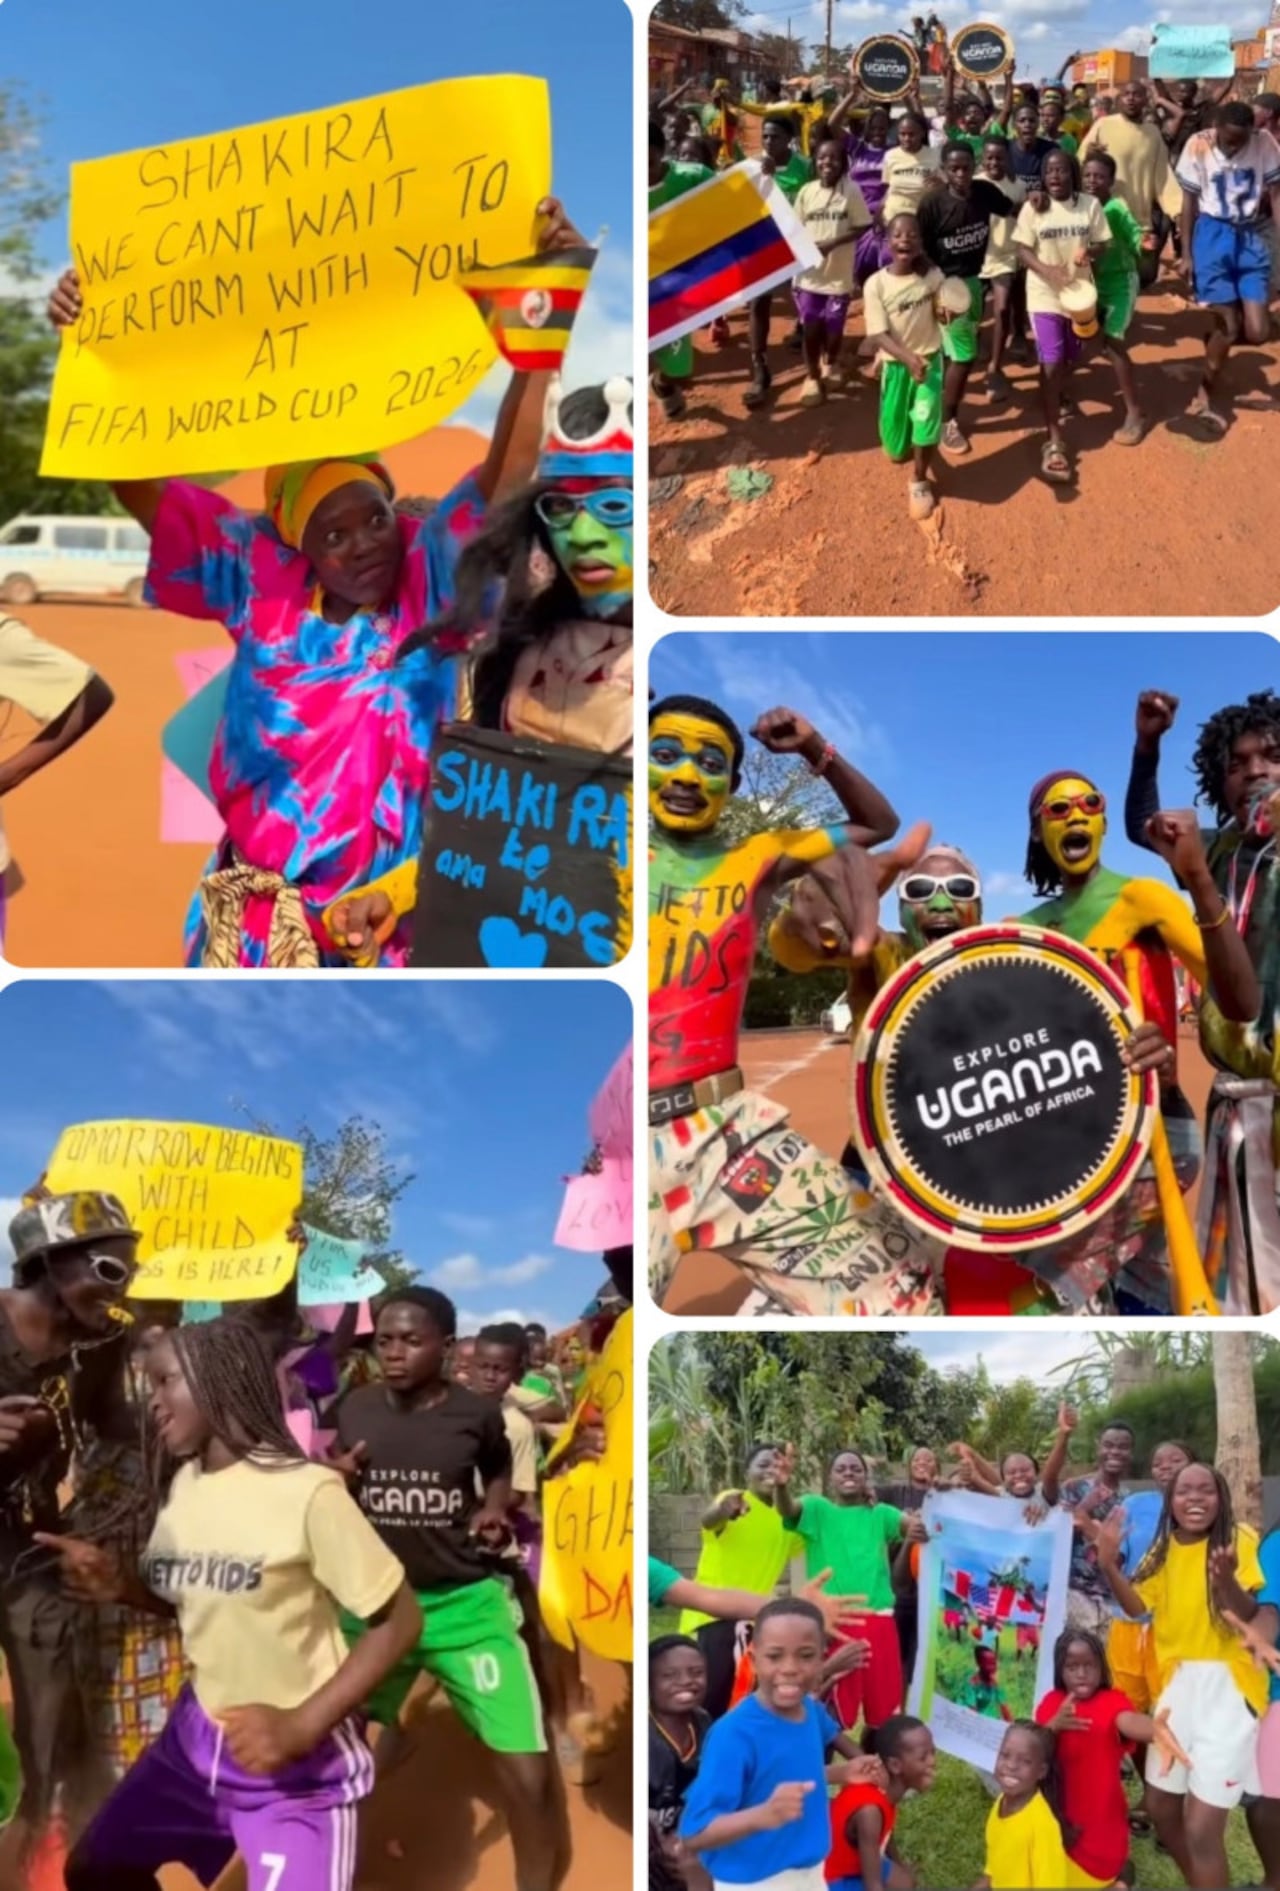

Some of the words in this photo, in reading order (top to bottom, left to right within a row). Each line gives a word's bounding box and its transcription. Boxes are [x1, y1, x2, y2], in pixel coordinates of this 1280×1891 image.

[137, 107, 394, 215] SHAKIRA
[76, 232, 136, 285] WE
[286, 168, 417, 248] WAIT
[452, 152, 509, 219] TO
[75, 273, 244, 358] PERFORM
[267, 252, 368, 312] WITH
[394, 237, 480, 296] YOU
[245, 322, 310, 381] AT
[58, 402, 148, 449] FIFA
[166, 391, 278, 443] WORLD
[289, 382, 359, 422] CUP
[384, 348, 482, 417] 2026
[648, 929, 740, 993] IDS
[952, 1028, 1051, 1072] EXPLORE
[916, 1038, 1103, 1130] UGANDA
[942, 1127, 974, 1148] THE
[974, 1108, 1023, 1137] PEARL
[1025, 1102, 1043, 1119] OF
[1046, 1084, 1096, 1112] AFRICA
[215, 1130, 298, 1181] BEGINS
[139, 1172, 209, 1213] WITH
[153, 1215, 256, 1252] CHILD
[370, 1469, 441, 1482] EXPLORE
[206, 1556, 264, 1593] KIDS
[467, 1653, 501, 1693] 10
[260, 1852, 287, 1891] 7
